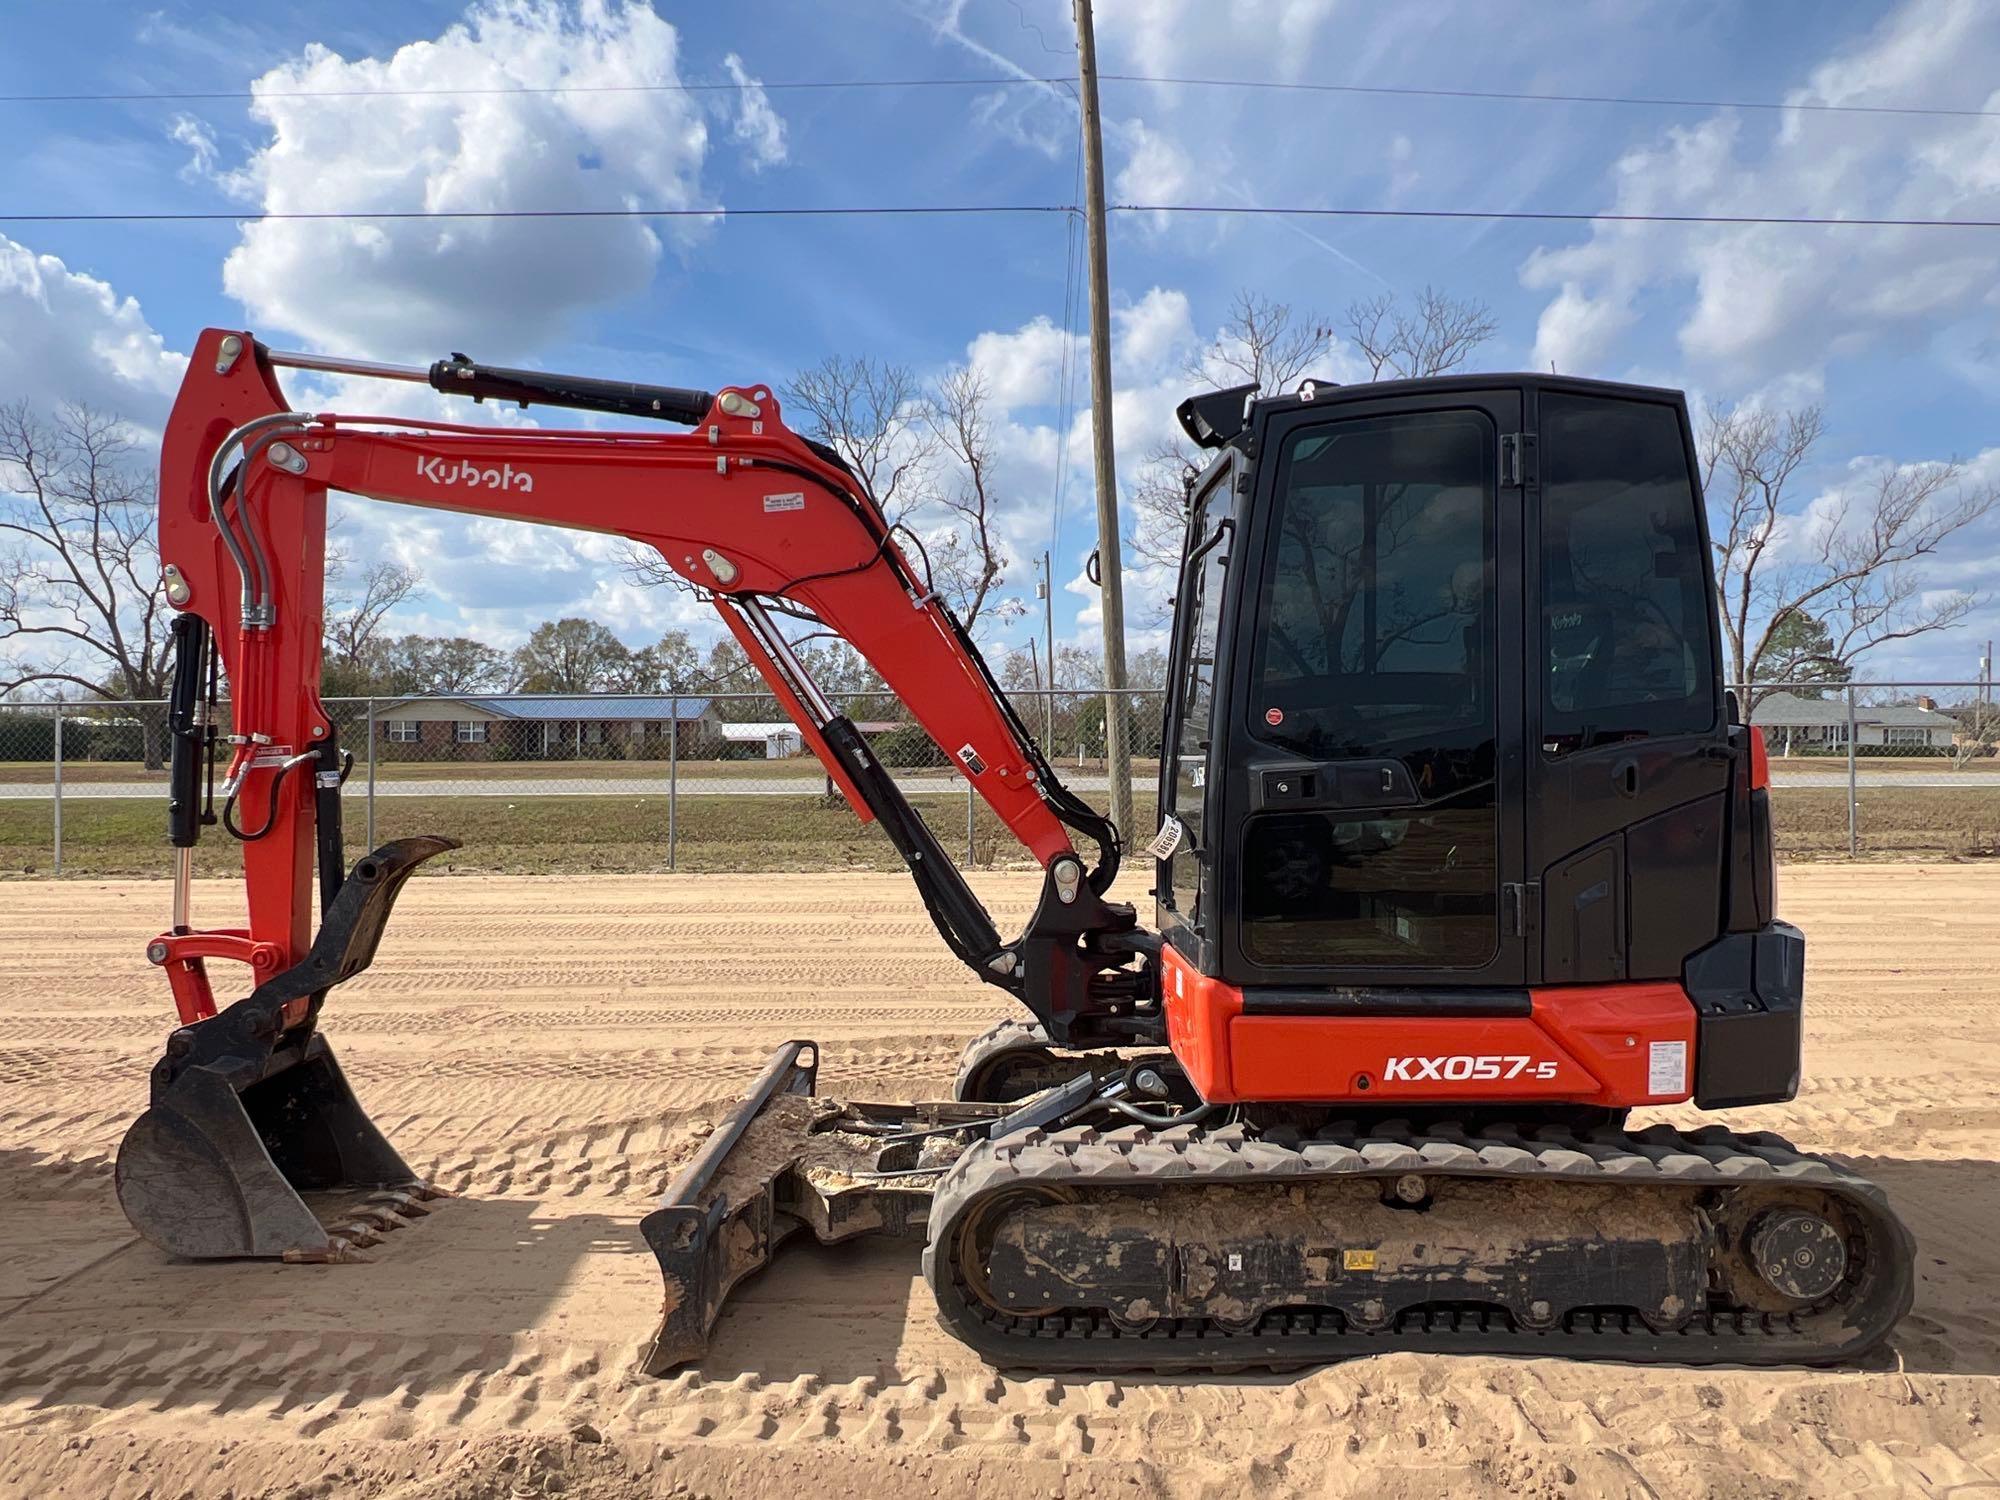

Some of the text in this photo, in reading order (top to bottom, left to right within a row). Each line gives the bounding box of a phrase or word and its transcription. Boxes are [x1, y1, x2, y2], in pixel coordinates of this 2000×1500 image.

[417, 455, 533, 493] Kubota
[1156, 826, 1179, 855] 206588
[1383, 1055, 1558, 1081] KX057-5
